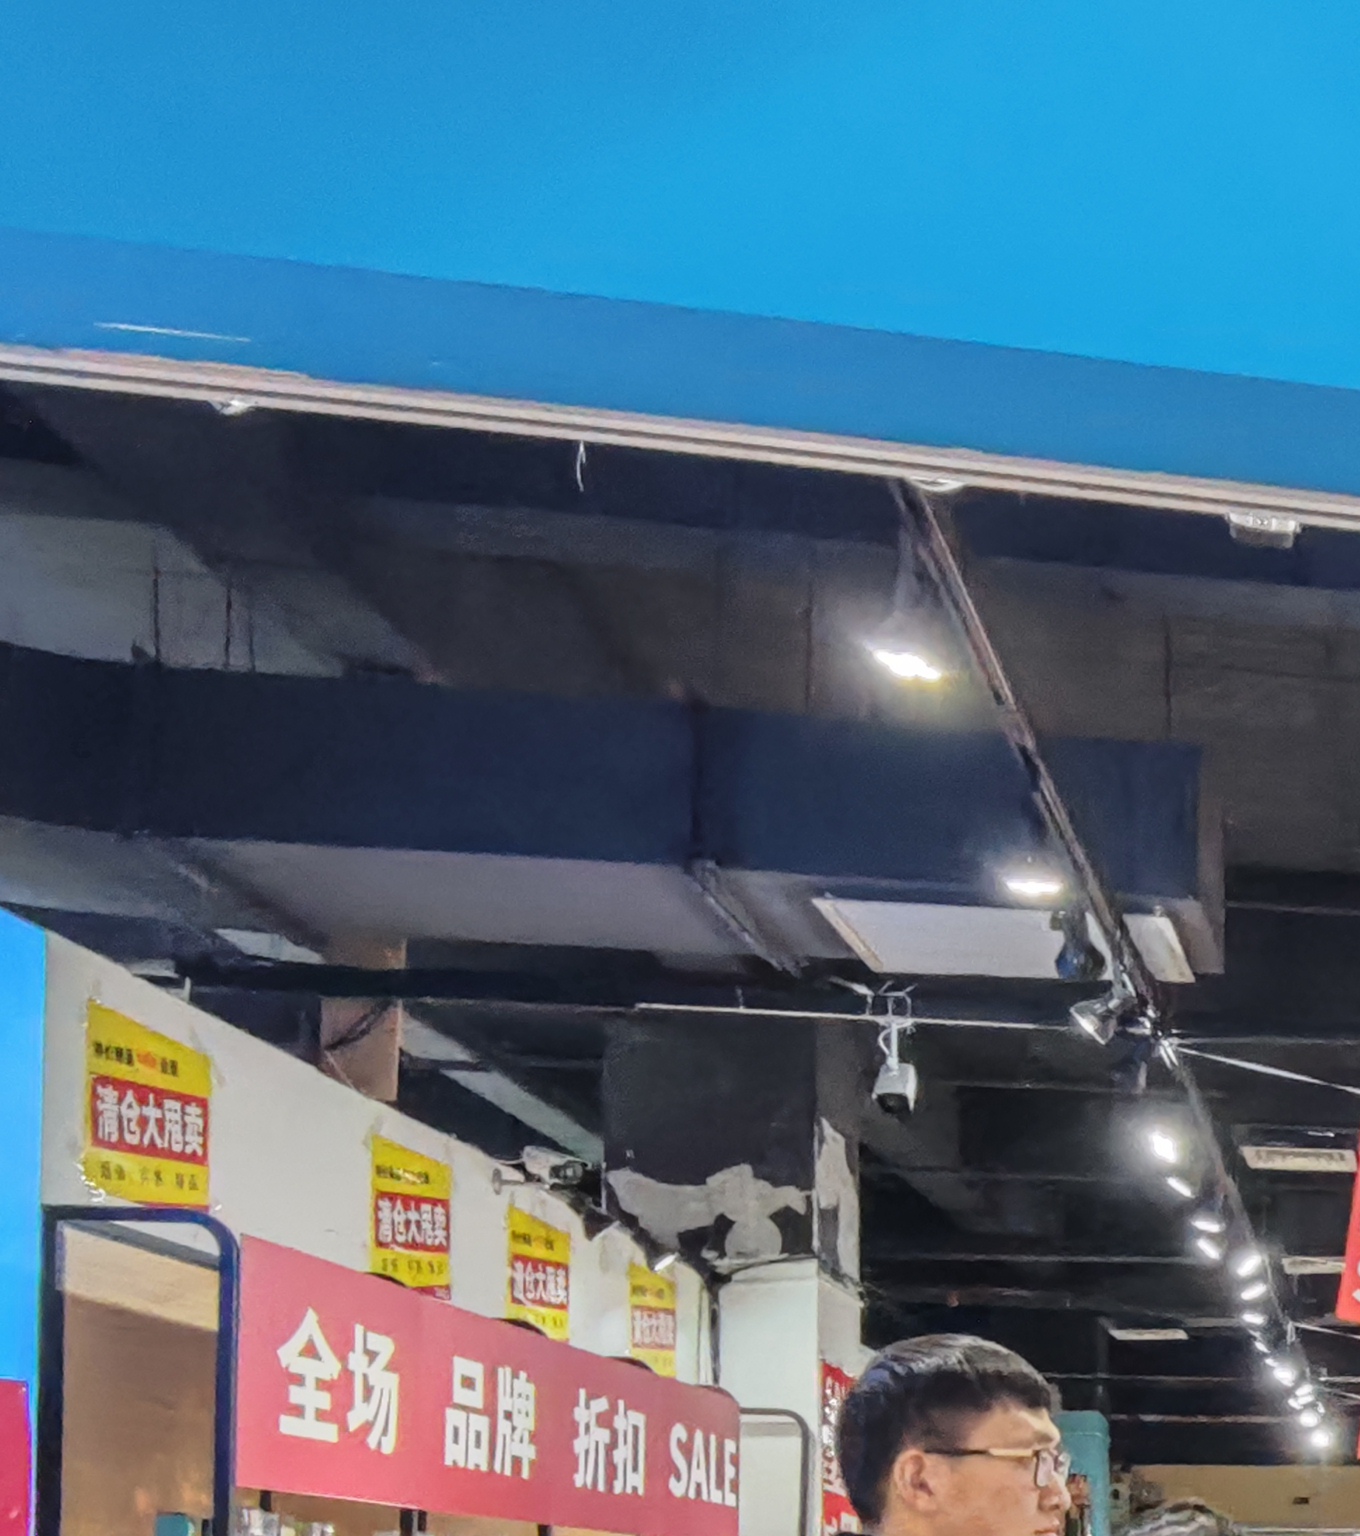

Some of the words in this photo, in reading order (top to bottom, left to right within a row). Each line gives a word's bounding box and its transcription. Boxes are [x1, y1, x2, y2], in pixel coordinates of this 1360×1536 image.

[96, 1084, 204, 1156] 清仓大甩卖
[276, 1306, 399, 1455] 全场
[443, 1355, 537, 1480] 品牌
[573, 1387, 647, 1496] 折扣
[668, 1421, 739, 1508] SALE
